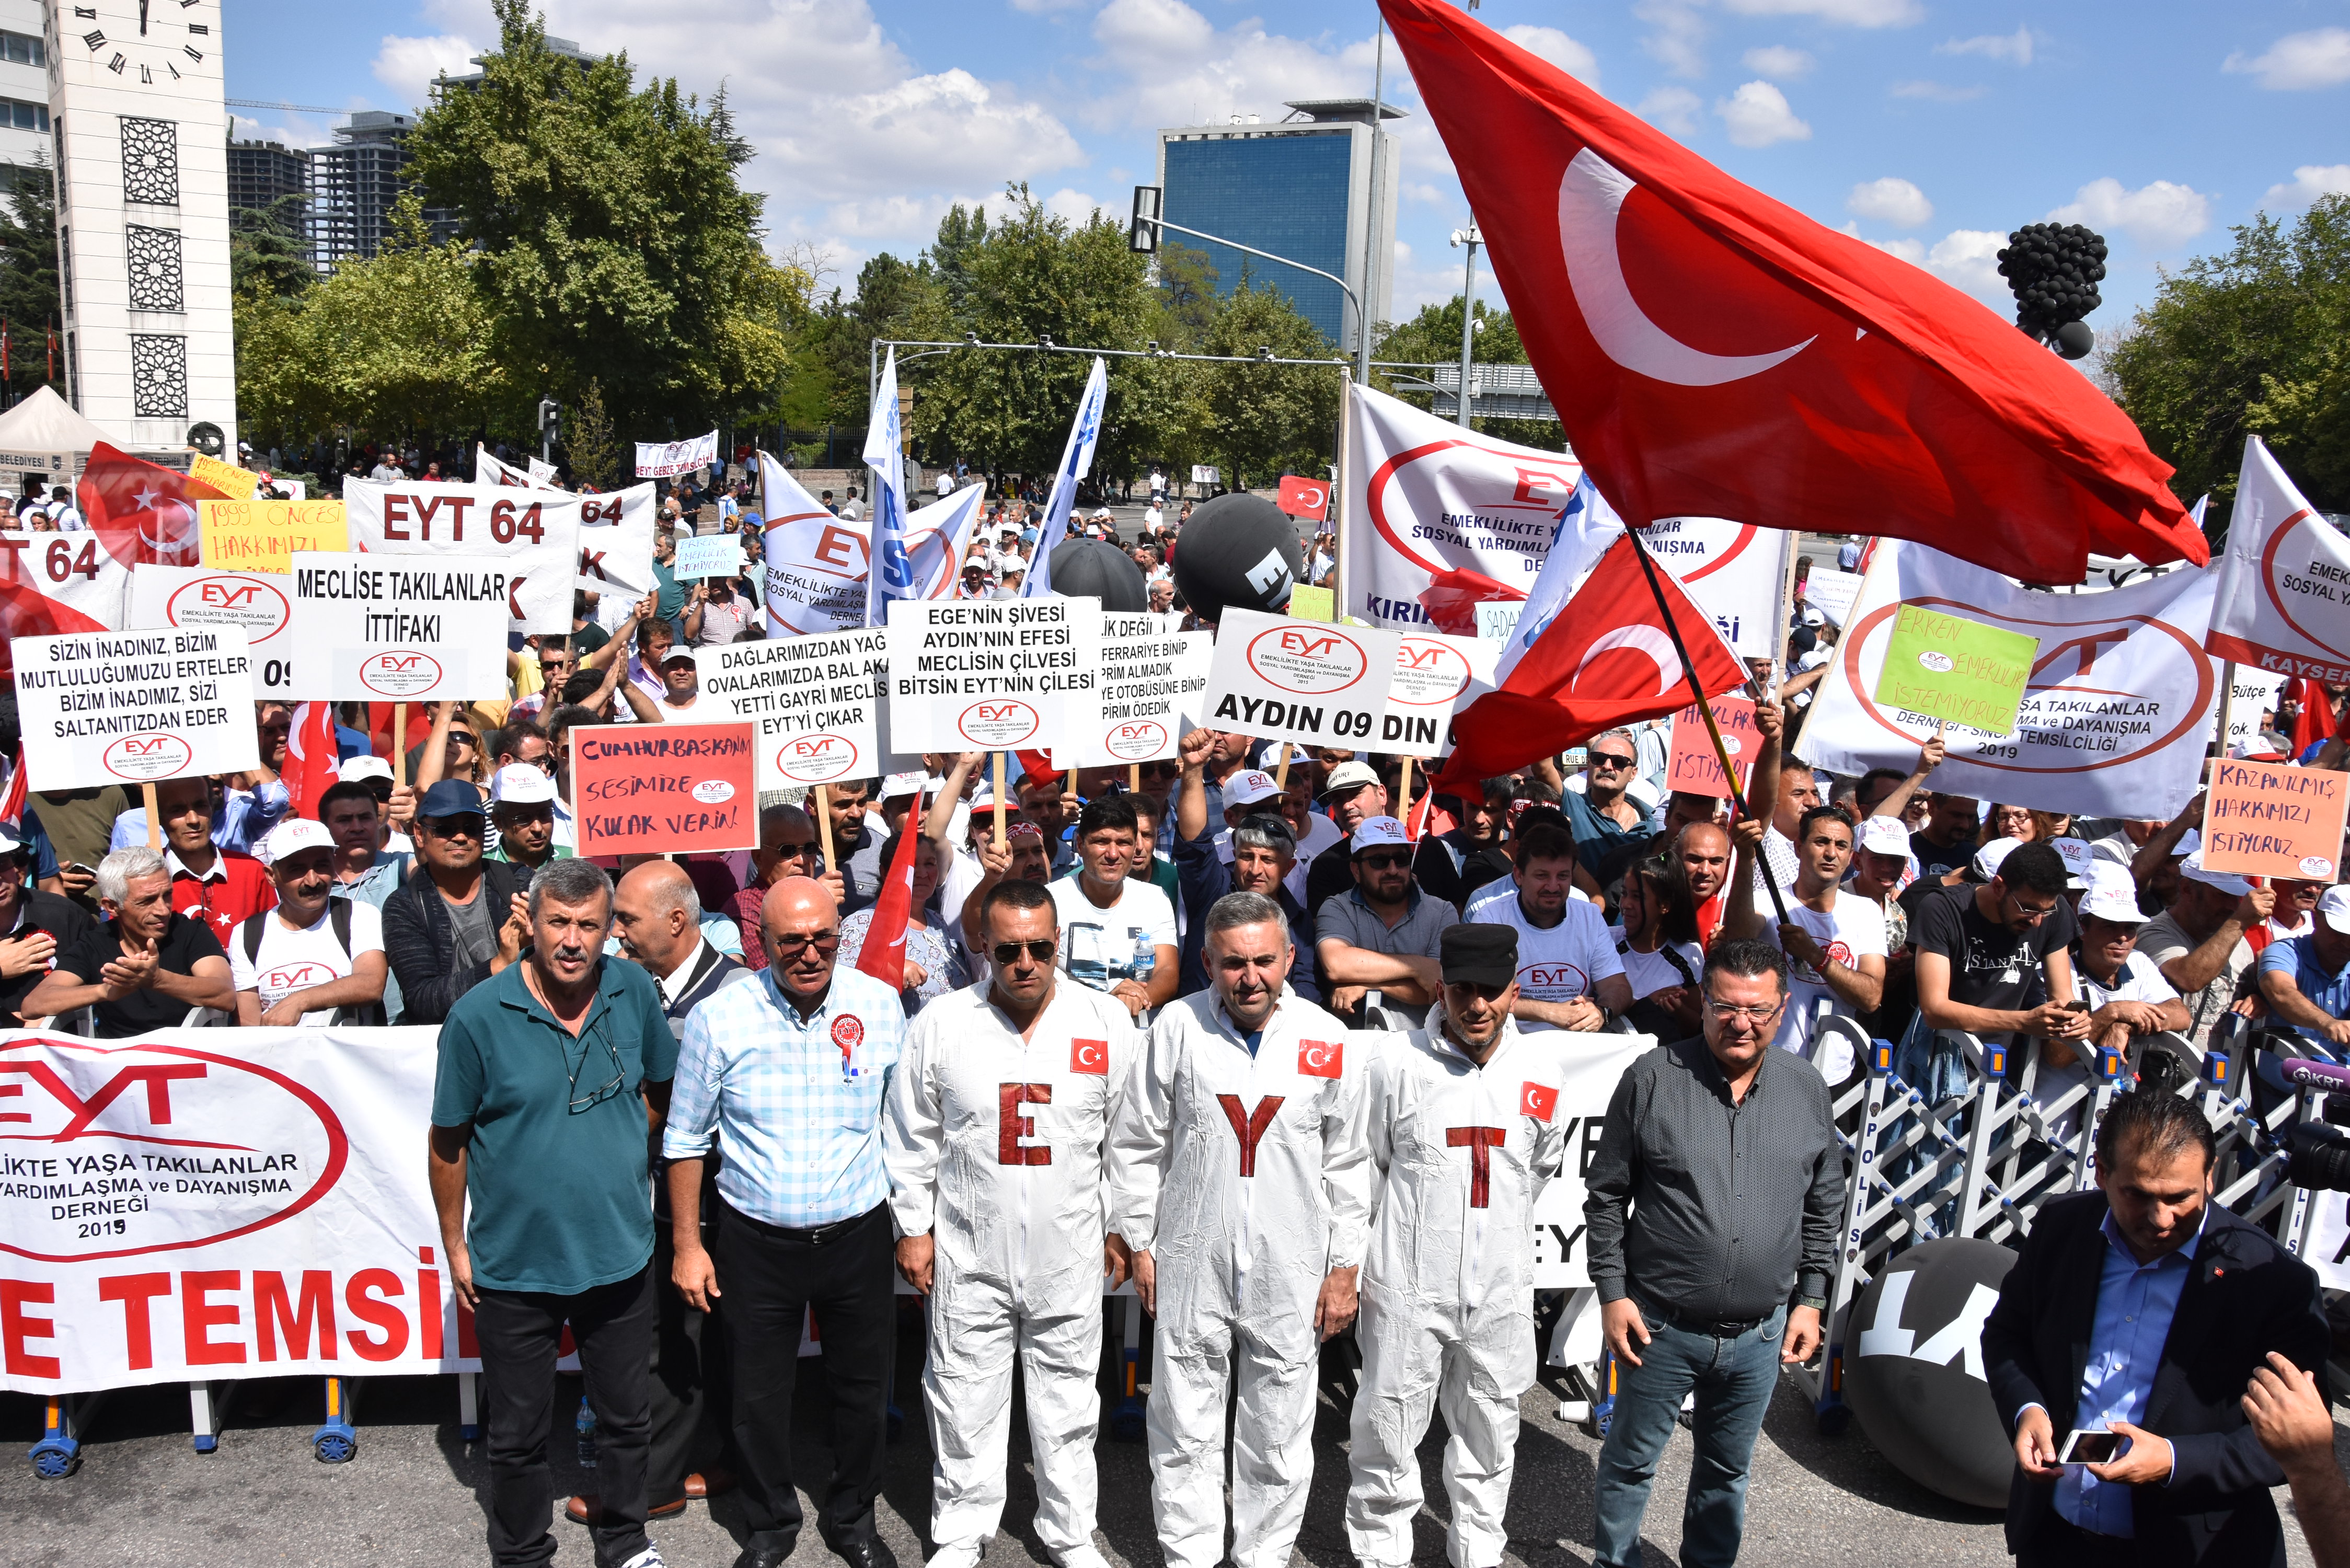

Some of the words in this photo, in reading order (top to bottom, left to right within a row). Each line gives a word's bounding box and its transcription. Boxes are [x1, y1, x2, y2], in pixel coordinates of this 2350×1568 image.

[1, 454, 44, 467] BELEDİYESİ
[197, 457, 220, 471] 1999
[654, 465, 674, 476] GEBZE
[211, 503, 251, 527] 1999
[267, 501, 343, 526] ÖNCESİ
[384, 493, 475, 541] EYT
[490, 499, 545, 545] 64
[581, 496, 624, 526] 64
[1441, 513, 1544, 536] EMEKLİLİKTE
[213, 535, 317, 560] HAKKIMIZI
[681, 538, 719, 549] ERKEN
[1412, 525, 1472, 549] SOSYAL
[46, 539, 100, 582] 64
[678, 548, 727, 561] EMEKLİLİK
[298, 563, 383, 599] MECLİSE
[390, 572, 505, 601] TAKILANLAR
[766, 566, 848, 597] EMEKLİLİKTE
[766, 580, 804, 604] SOSYAL
[2283, 574, 2335, 601] SOSYAL
[202, 584, 262, 607] EYT
[365, 607, 441, 642] İTTİFAKI
[929, 604, 1002, 625] EGE'NİN
[1008, 602, 1065, 627] ŞİVESİ
[1897, 608, 1963, 641] ERKEN
[50, 640, 91, 662] SİZİN
[96, 637, 171, 659] İNADINIZ,
[175, 630, 217, 653] BİZİM
[924, 630, 1013, 648] AYDIN'NIN
[1021, 625, 1070, 645] EFESİ
[1280, 631, 1341, 656] EYT
[721, 639, 850, 670] DAĞLARIMIZDAN
[854, 630, 886, 652] YAĞ
[918, 650, 1004, 672] MECLİSİN
[1010, 648, 1076, 673] ÇİLVESİ
[1102, 641, 1159, 661] FERRARİYE
[1162, 639, 1188, 656] BİNİP
[1928, 653, 1946, 661] EYT
[21, 662, 171, 689] MUTLULUĞUMUZU
[177, 656, 248, 678] ERTELER
[382, 657, 421, 671] EYT
[1127, 662, 1172, 678] ALMADIK
[1261, 654, 1299, 665] EMEKLİLİKTE
[1317, 663, 1352, 672] TAKILANLAR
[1280, 664, 1315, 674] YARDIMLAŞMA
[1954, 653, 2026, 691] EMEKLİLİK
[707, 665, 825, 694] OVALARIMIZDA
[827, 662, 859, 679] BAL
[899, 675, 958, 695] BİTSİN
[964, 673, 1033, 694] EYT'NİN
[1039, 670, 1095, 695] ÇİLESİ
[1117, 679, 1178, 699] OTOBÜSÜNE
[1181, 675, 1205, 693] BİNİP
[60, 689, 105, 712] BİZİM
[110, 686, 185, 708] İNADIMIZ,
[189, 680, 217, 701] SİZİ
[731, 691, 776, 715] YETTİ
[780, 685, 826, 709] GAYRİ
[831, 678, 888, 702] MECLİS
[2048, 700, 2160, 716] TAKILANLAR
[763, 710, 811, 734] EYT'Yİ
[815, 708, 863, 732] ÇIKAR
[979, 705, 1018, 721] EYT
[1102, 702, 1130, 720] PİRİM
[1133, 698, 1170, 717] ÖDEDİK
[1214, 693, 1324, 733] AYDIN
[1333, 710, 1372, 737] 09
[54, 711, 180, 737] SALTANITIZDAN
[186, 707, 228, 727] EDER
[1122, 725, 1151, 739] EYT
[2043, 717, 2058, 728] ve
[2063, 719, 2151, 737] DAYANIŞMA
[125, 738, 167, 754] EYT
[796, 739, 834, 756] EYT
[1976, 742, 2018, 759] 2019
[2019, 729, 2117, 752] TEMSİLCİLİĞİ
[1566, 755, 1579, 764] RUE
[586, 774, 692, 801] SESİMİZE
[702, 782, 724, 791] EYT
[1248, 774, 1268, 786] EYT
[2219, 764, 2335, 800] KAZANILMIŞ
[2214, 798, 2310, 824] HAKKIMIZI
[585, 814, 658, 841] KULAK
[1384, 822, 1397, 832] EYT
[2067, 844, 2082, 856] EYT
[271, 967, 313, 988] EYT
[1532, 969, 1568, 986] EYT
[838, 1026, 856, 1035] EYT
[2312, 1073, 2343, 1090] KRT
[998, 1082, 1052, 1166] E
[1215, 1093, 1286, 1178] Y
[66, 1153, 137, 1177] YAŞA
[142, 1154, 298, 1174] TAKILANLAR
[1446, 1126, 1507, 1209] T
[148, 1180, 169, 1193] ve
[176, 1179, 292, 1197] DAYANIŞMA
[1850, 1123, 1877, 1243] POLİS
[51, 1193, 149, 1220] DERNEĞİ
